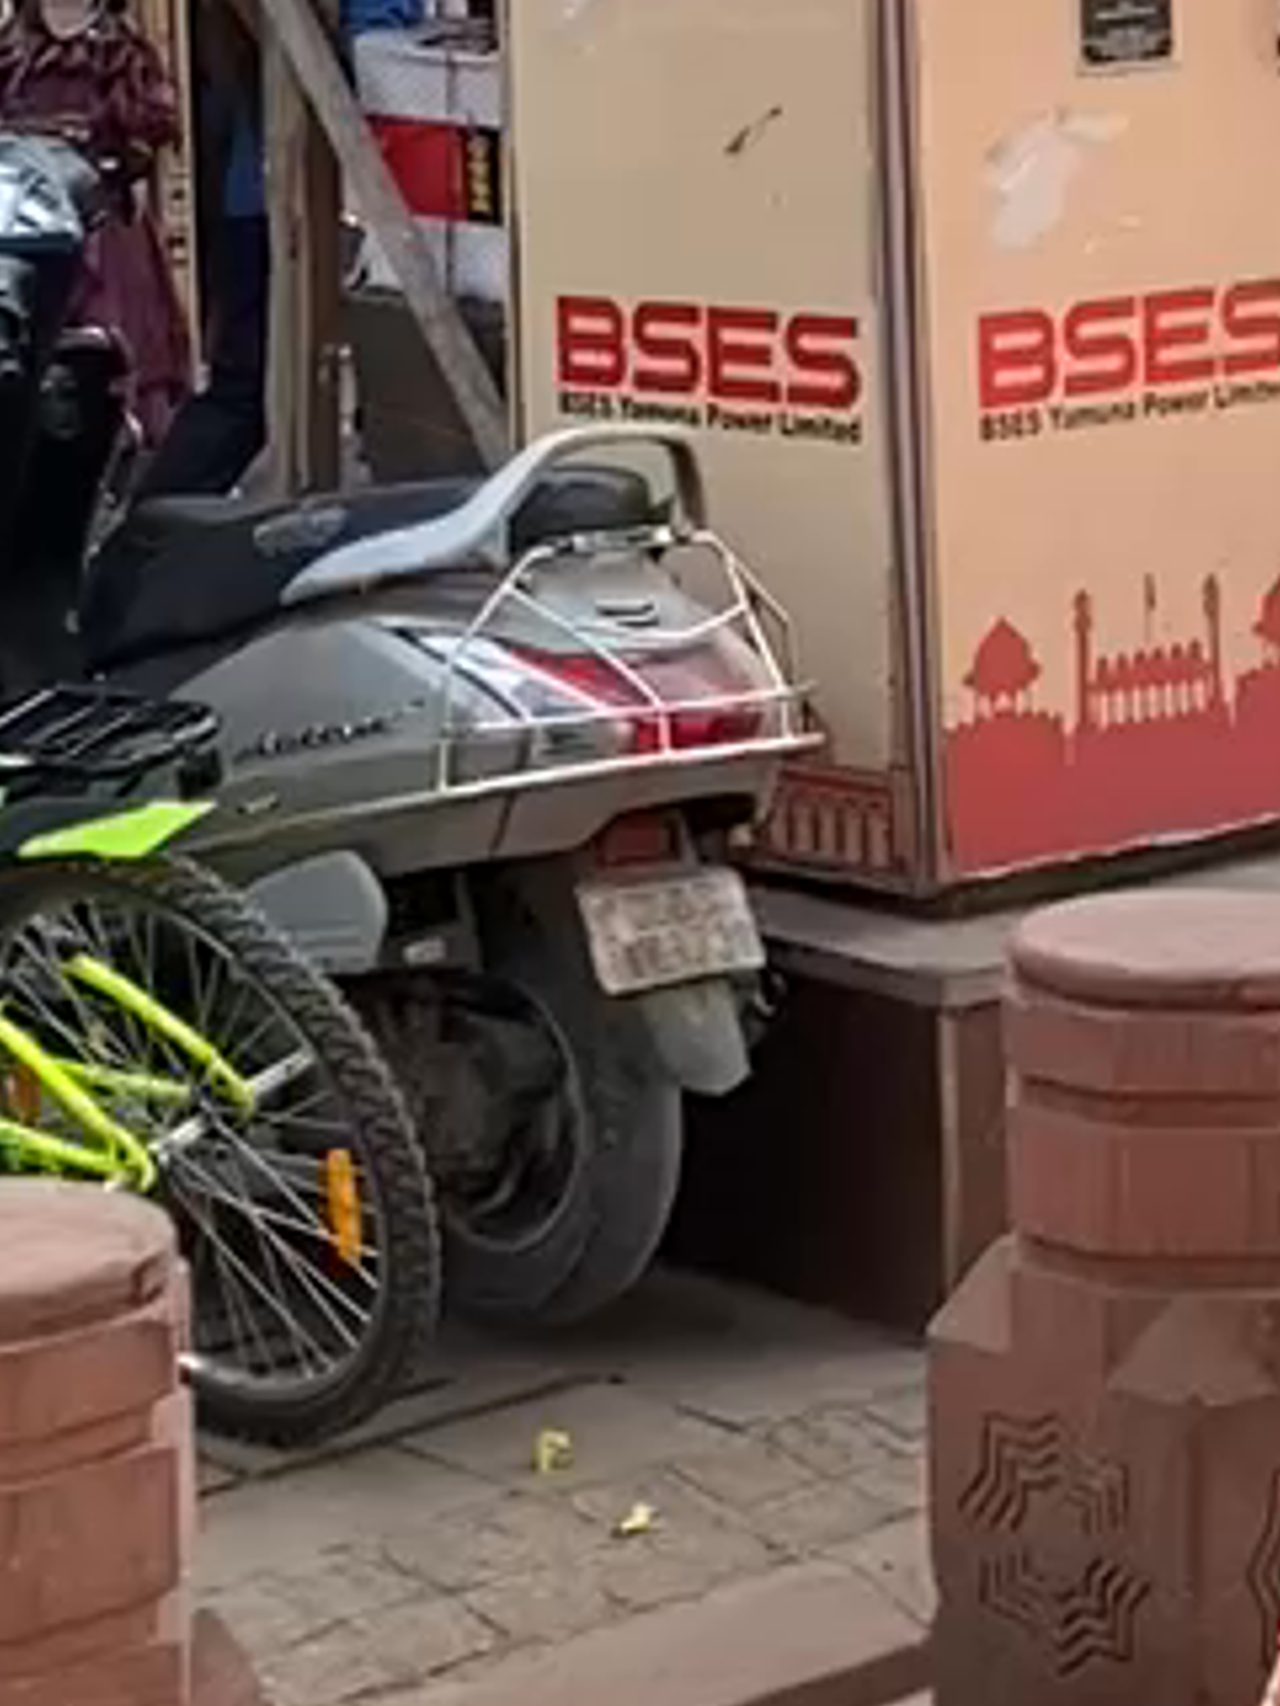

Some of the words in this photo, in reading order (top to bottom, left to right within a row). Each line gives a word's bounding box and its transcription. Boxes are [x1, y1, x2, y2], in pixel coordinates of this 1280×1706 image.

[557, 295, 861, 410] BSES
[559, 391, 613, 420] BSES
[620, 395, 702, 426] Yamuna
[706, 403, 773, 434] Power
[779, 413, 862, 445] Limited
[979, 407, 1043, 442] BSES
[1048, 400, 1136, 432] Yamuna
[1143, 390, 1210, 418] Power
